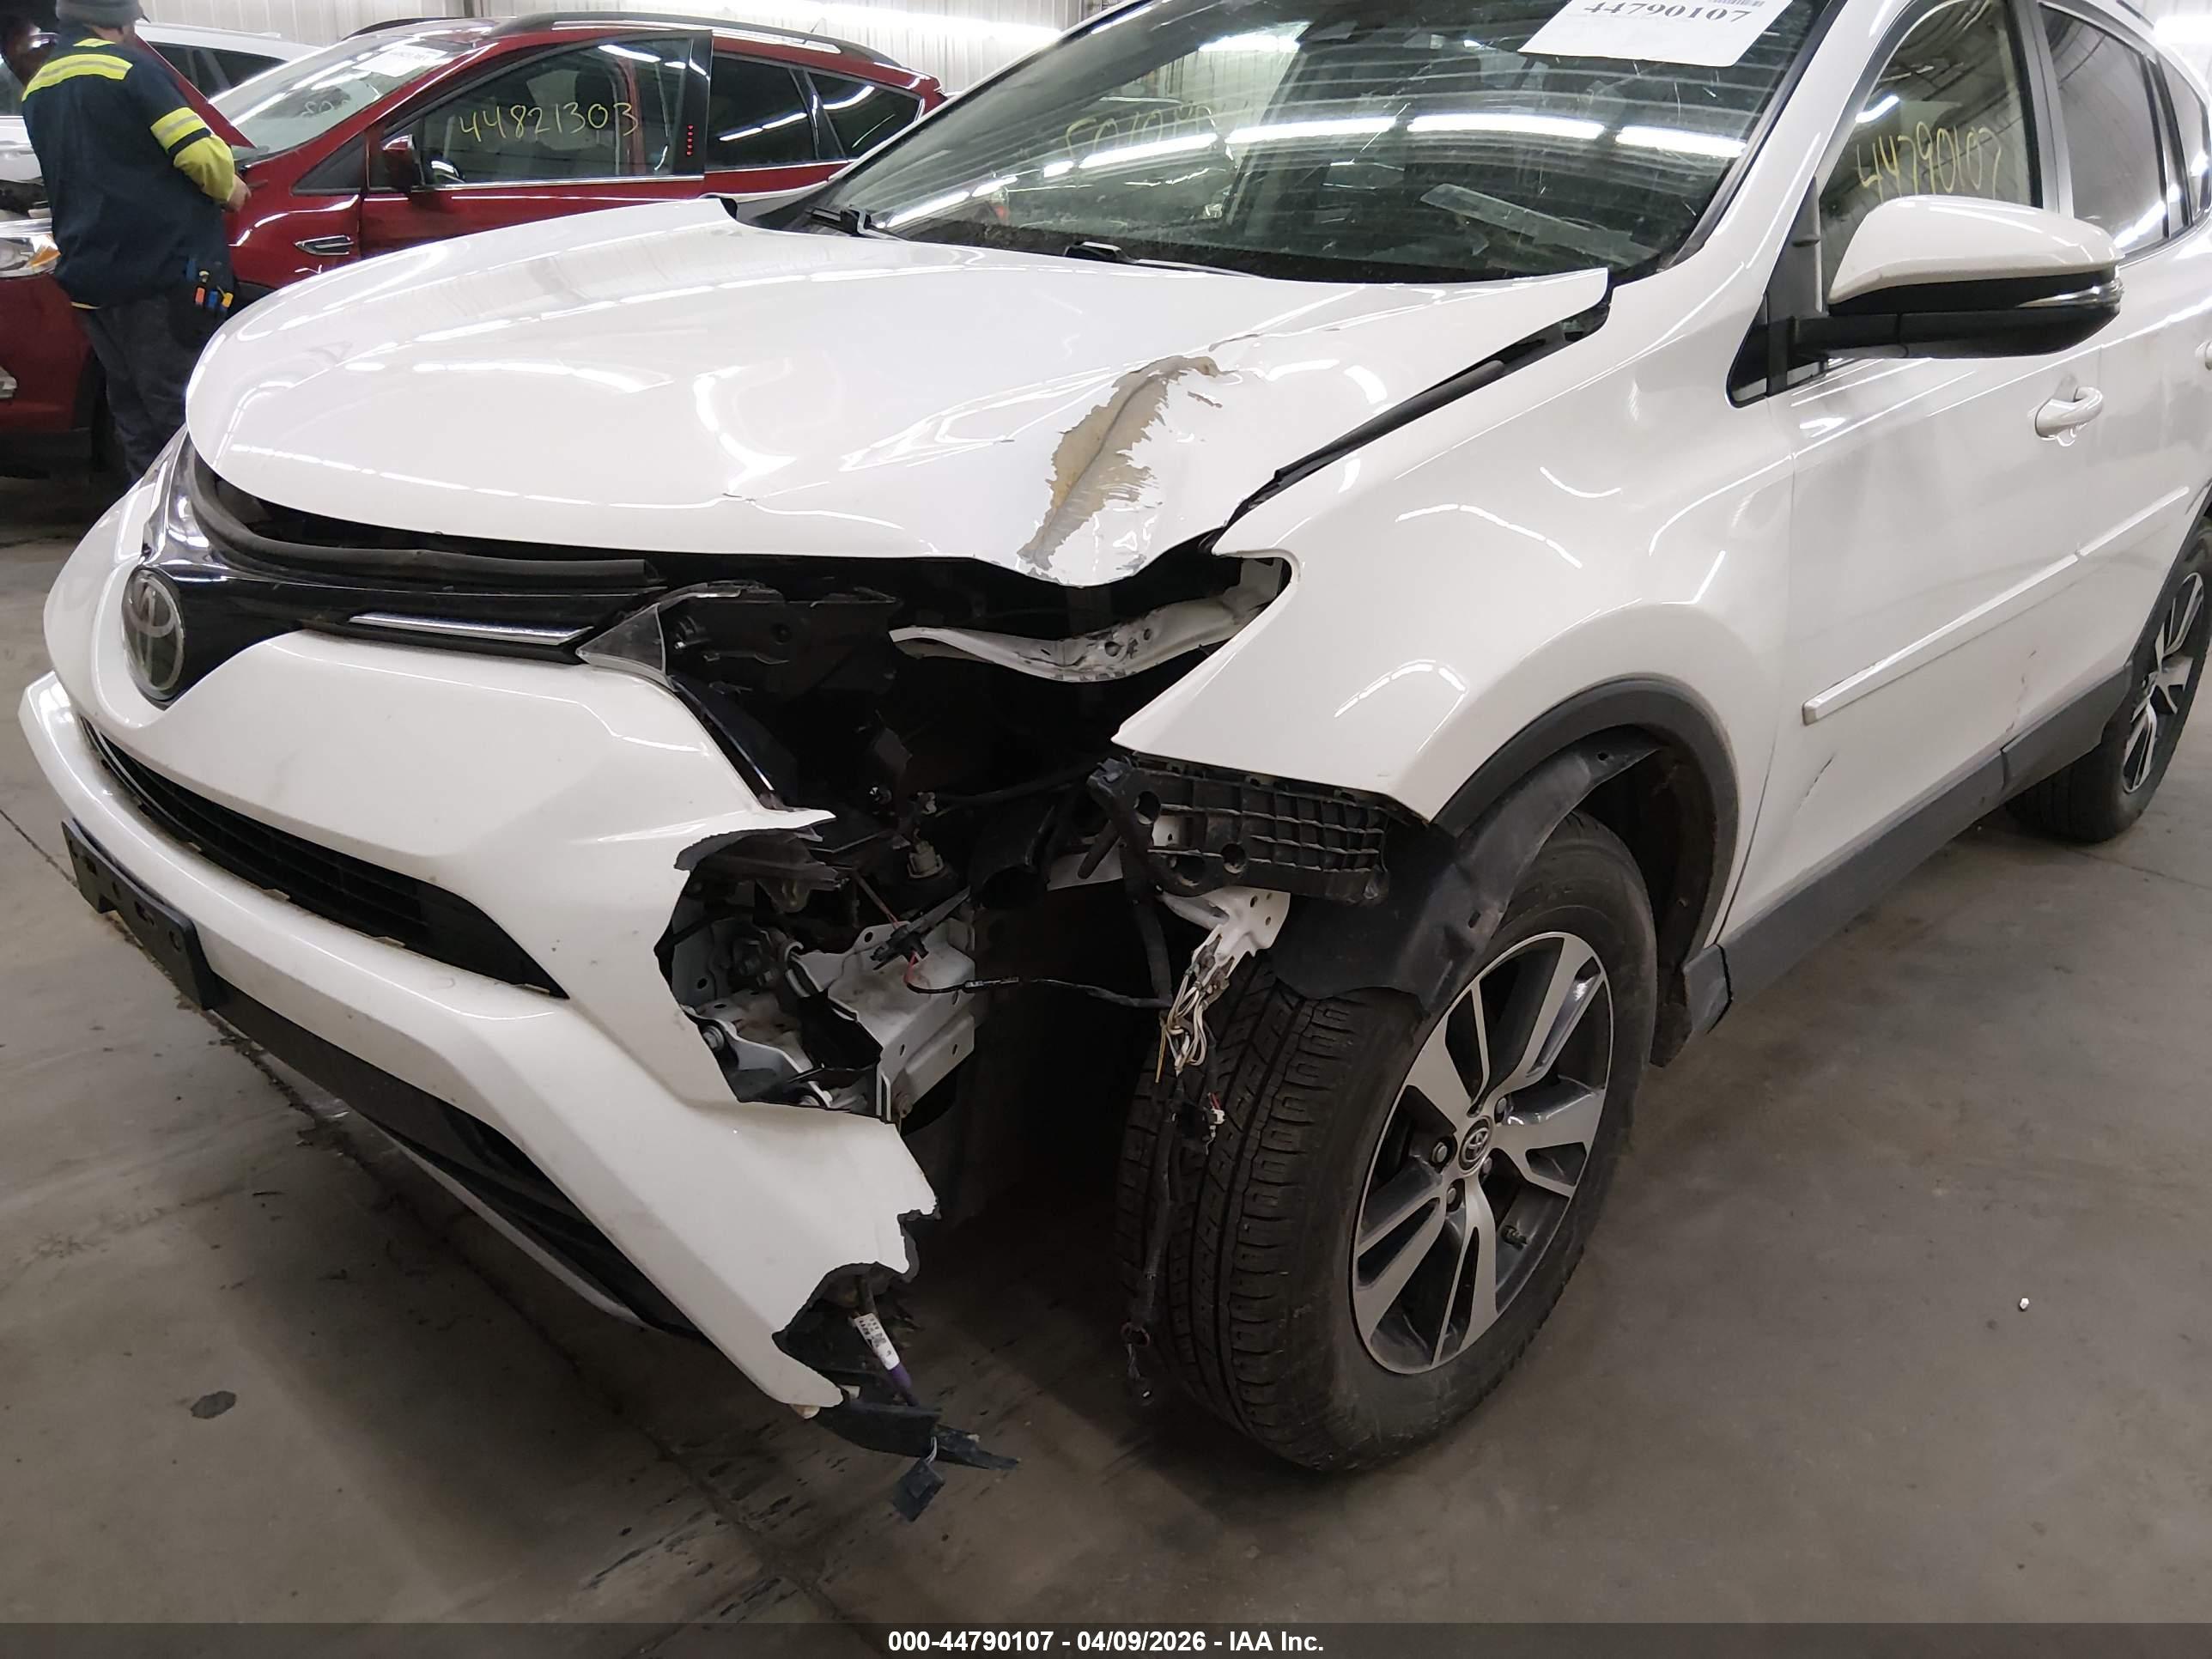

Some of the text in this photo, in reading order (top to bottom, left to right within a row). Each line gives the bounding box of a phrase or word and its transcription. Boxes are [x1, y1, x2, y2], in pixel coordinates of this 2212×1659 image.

[1584, 1, 1752, 22] 44790107
[459, 101, 639, 143] 44821303
[1856, 120, 2002, 204] 44790107
